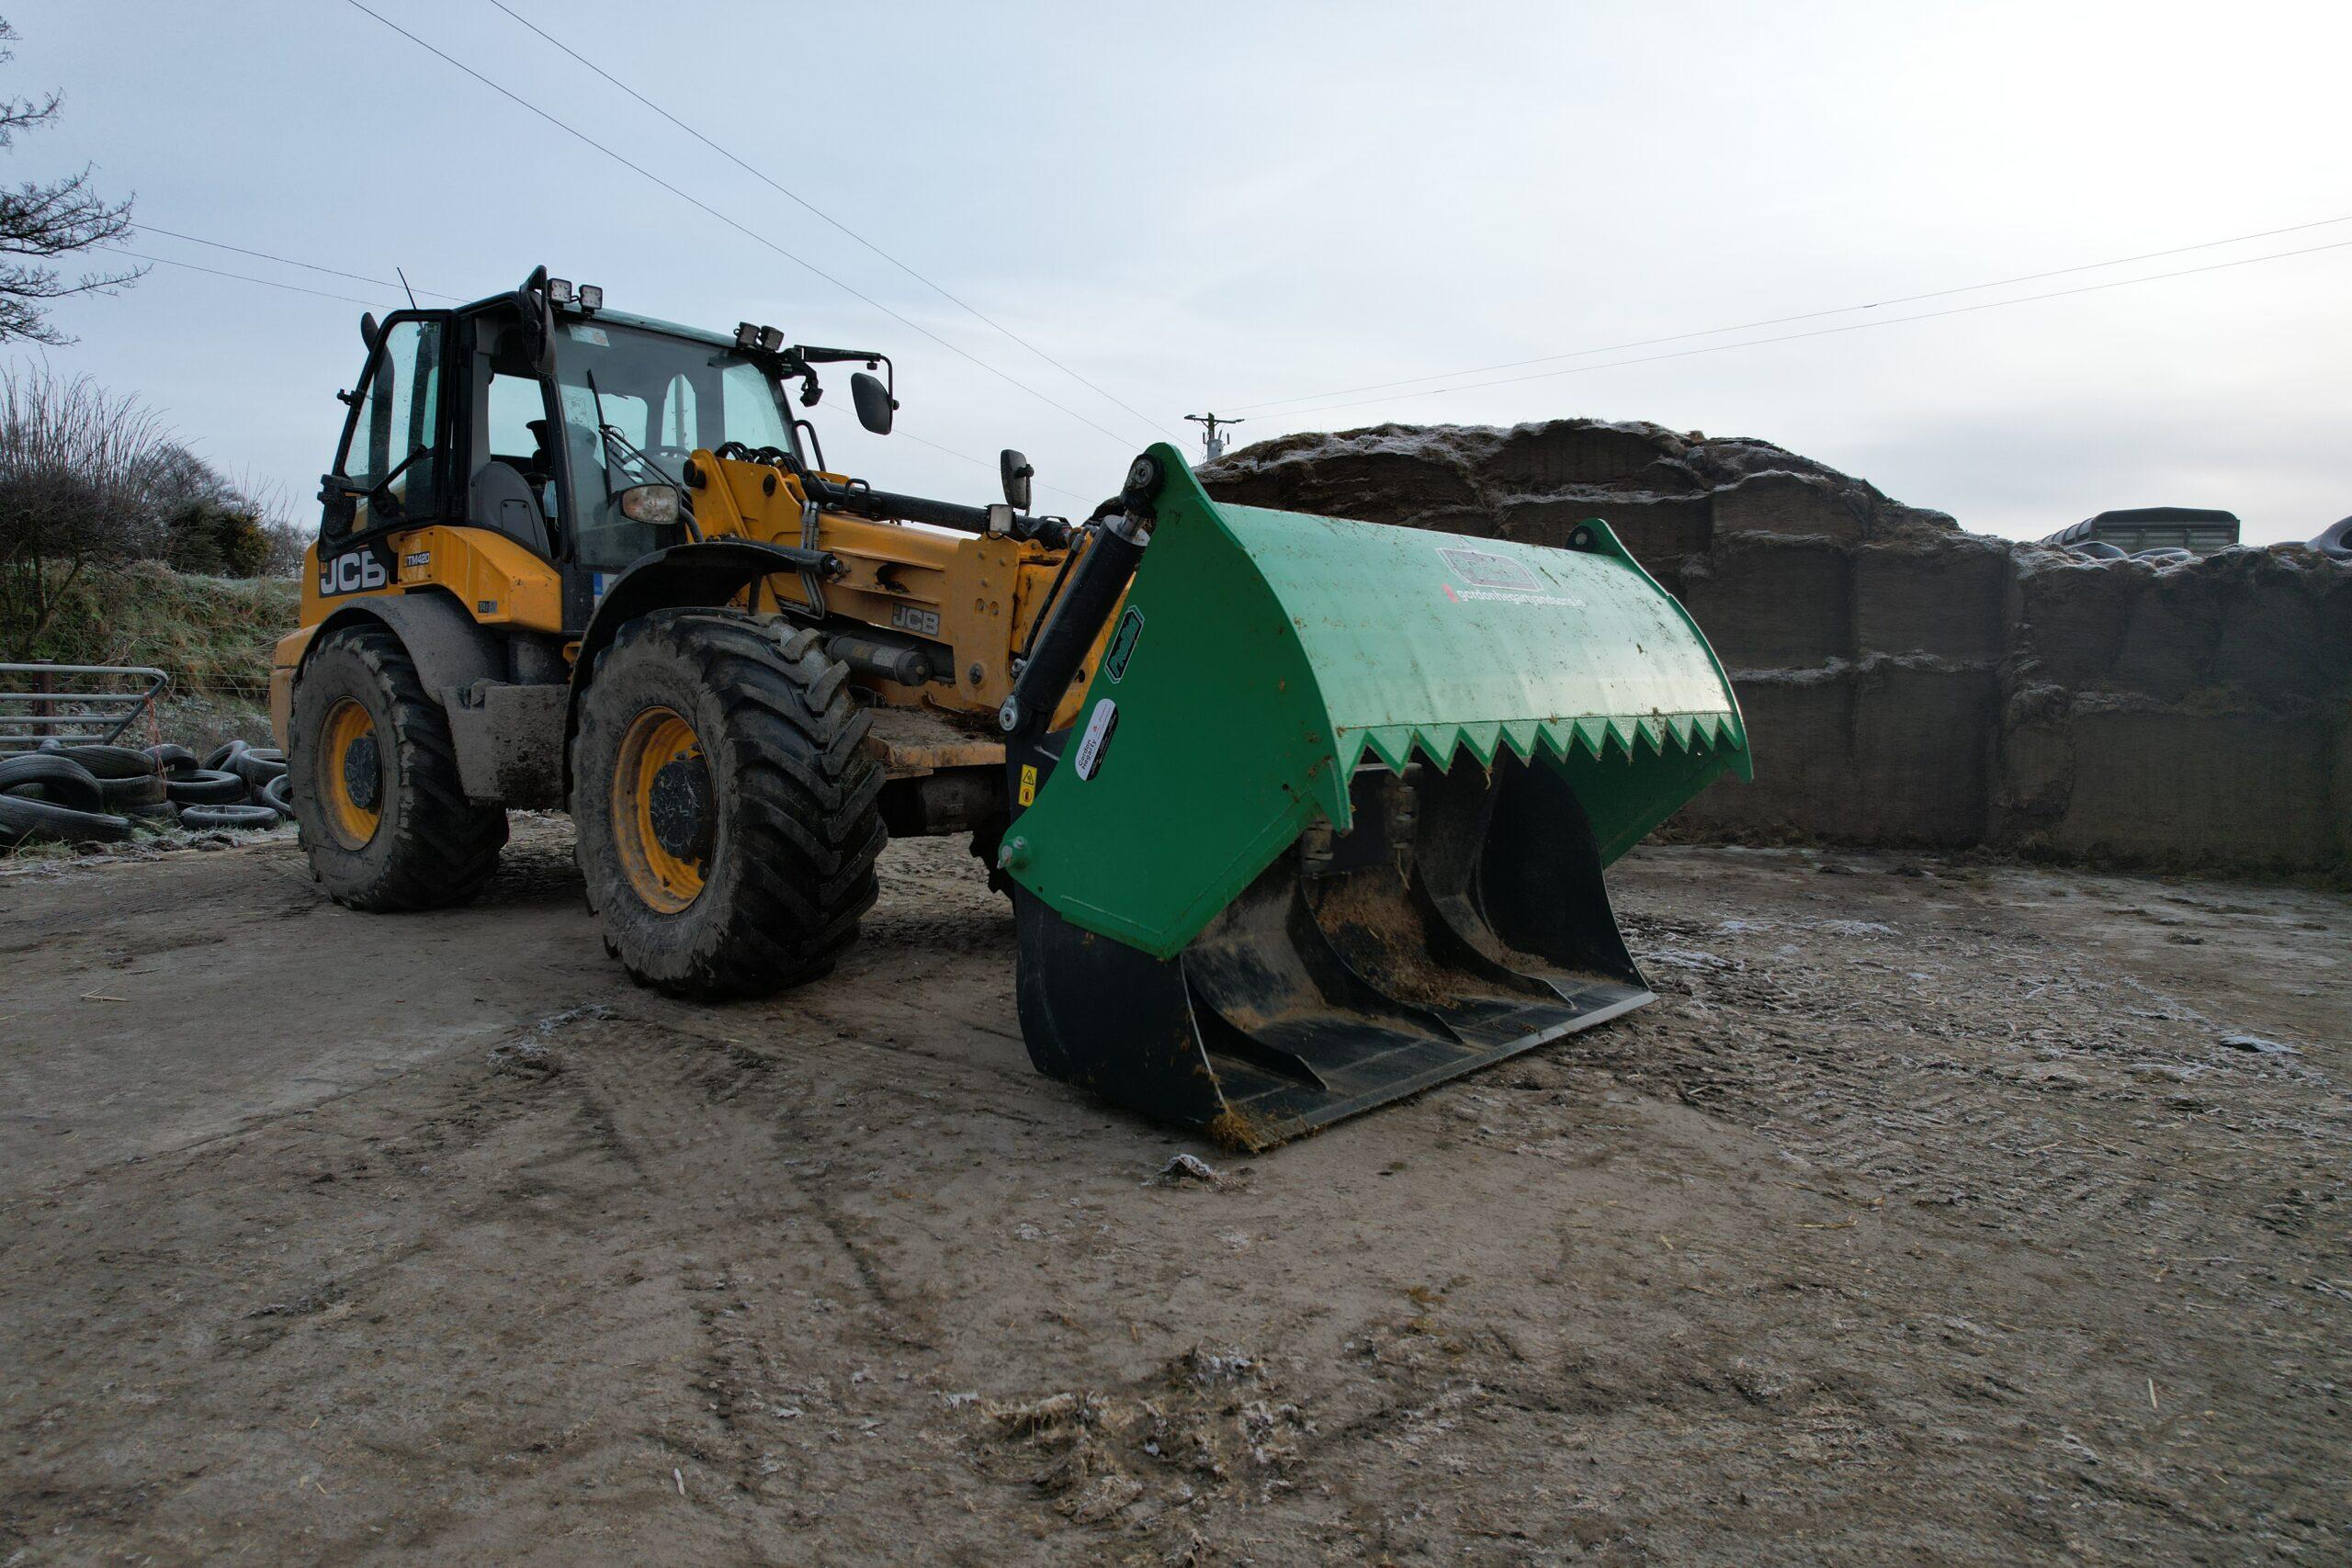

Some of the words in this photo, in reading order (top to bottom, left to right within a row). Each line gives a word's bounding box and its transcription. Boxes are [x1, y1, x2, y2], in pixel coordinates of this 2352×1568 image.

[407, 552, 430, 566] TM420
[893, 606, 939, 635] JCB
[1078, 739, 1091, 767] Gordon
[1081, 739, 1097, 770] Hegarty
